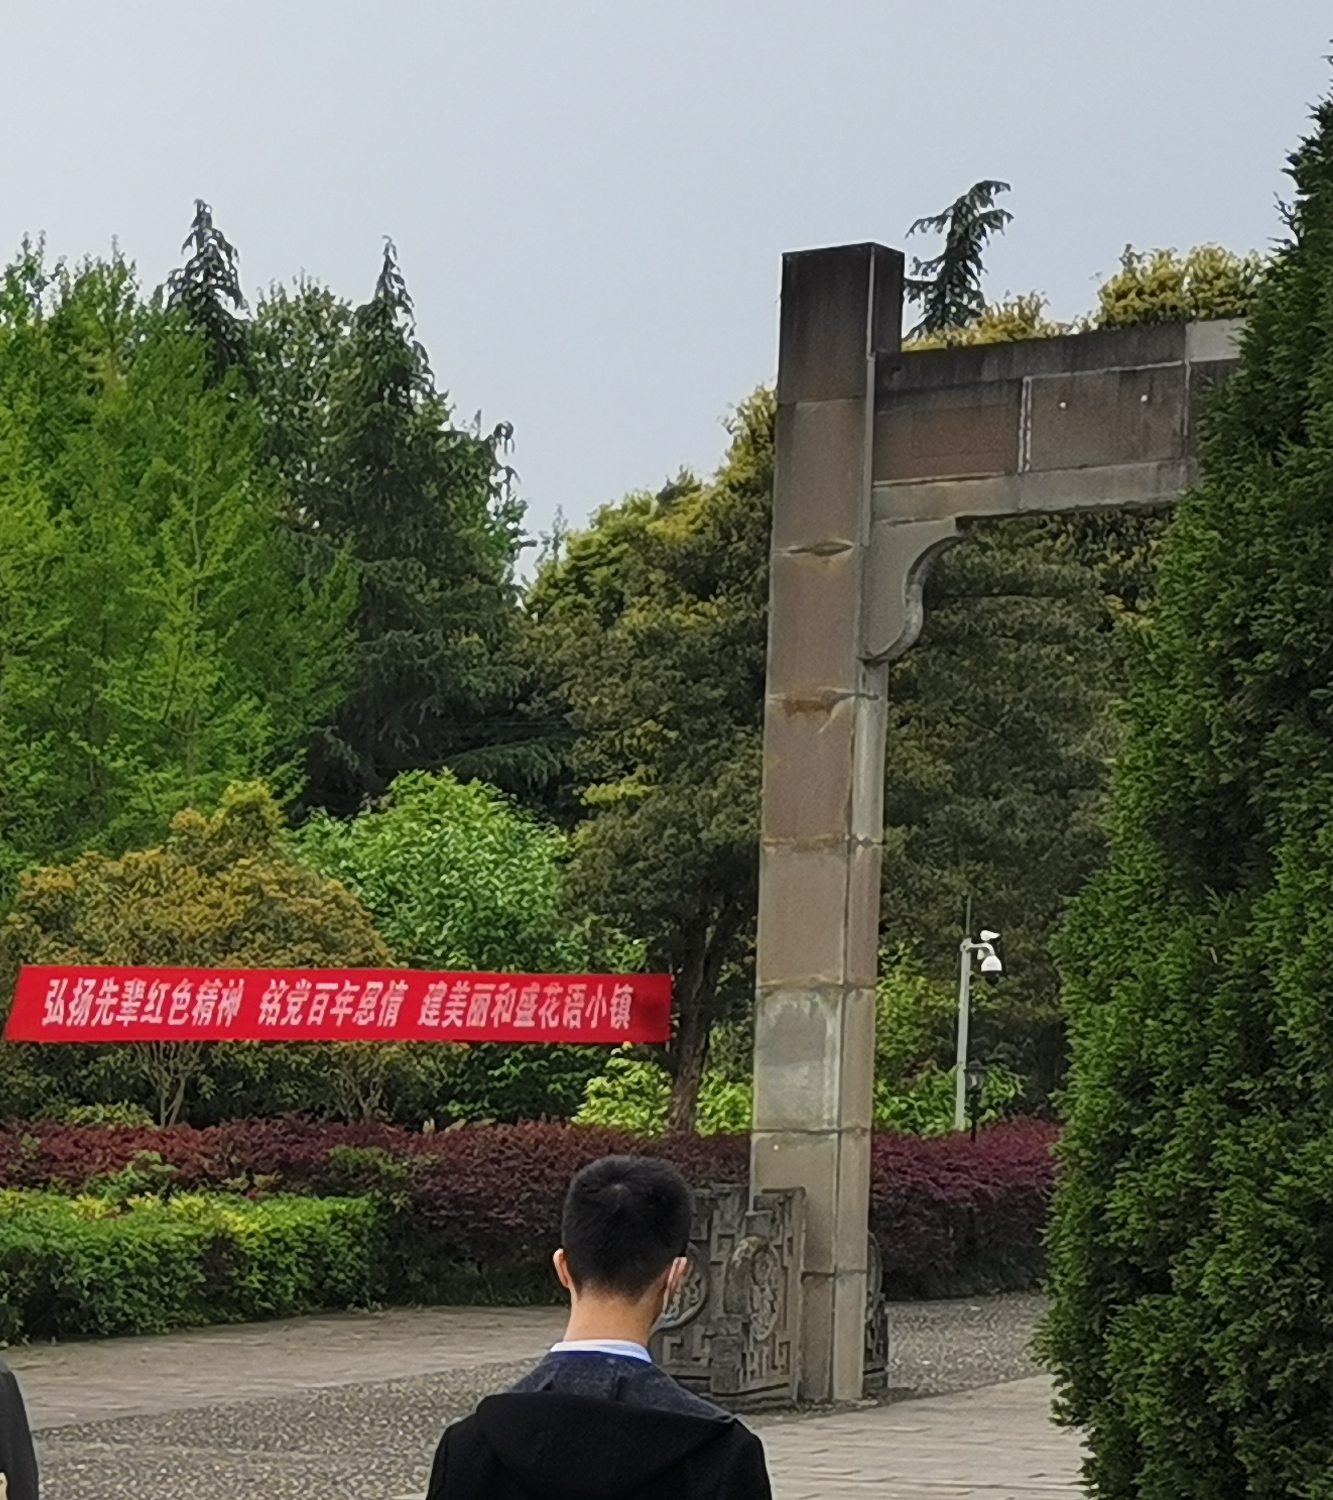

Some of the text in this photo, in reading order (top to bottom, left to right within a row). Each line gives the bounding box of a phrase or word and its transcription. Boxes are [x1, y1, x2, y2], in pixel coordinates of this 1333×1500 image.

[42, 977, 634, 1029] 弘扬先辈红色精神 铭党百年恩情 建美丽和盛花语小镇
